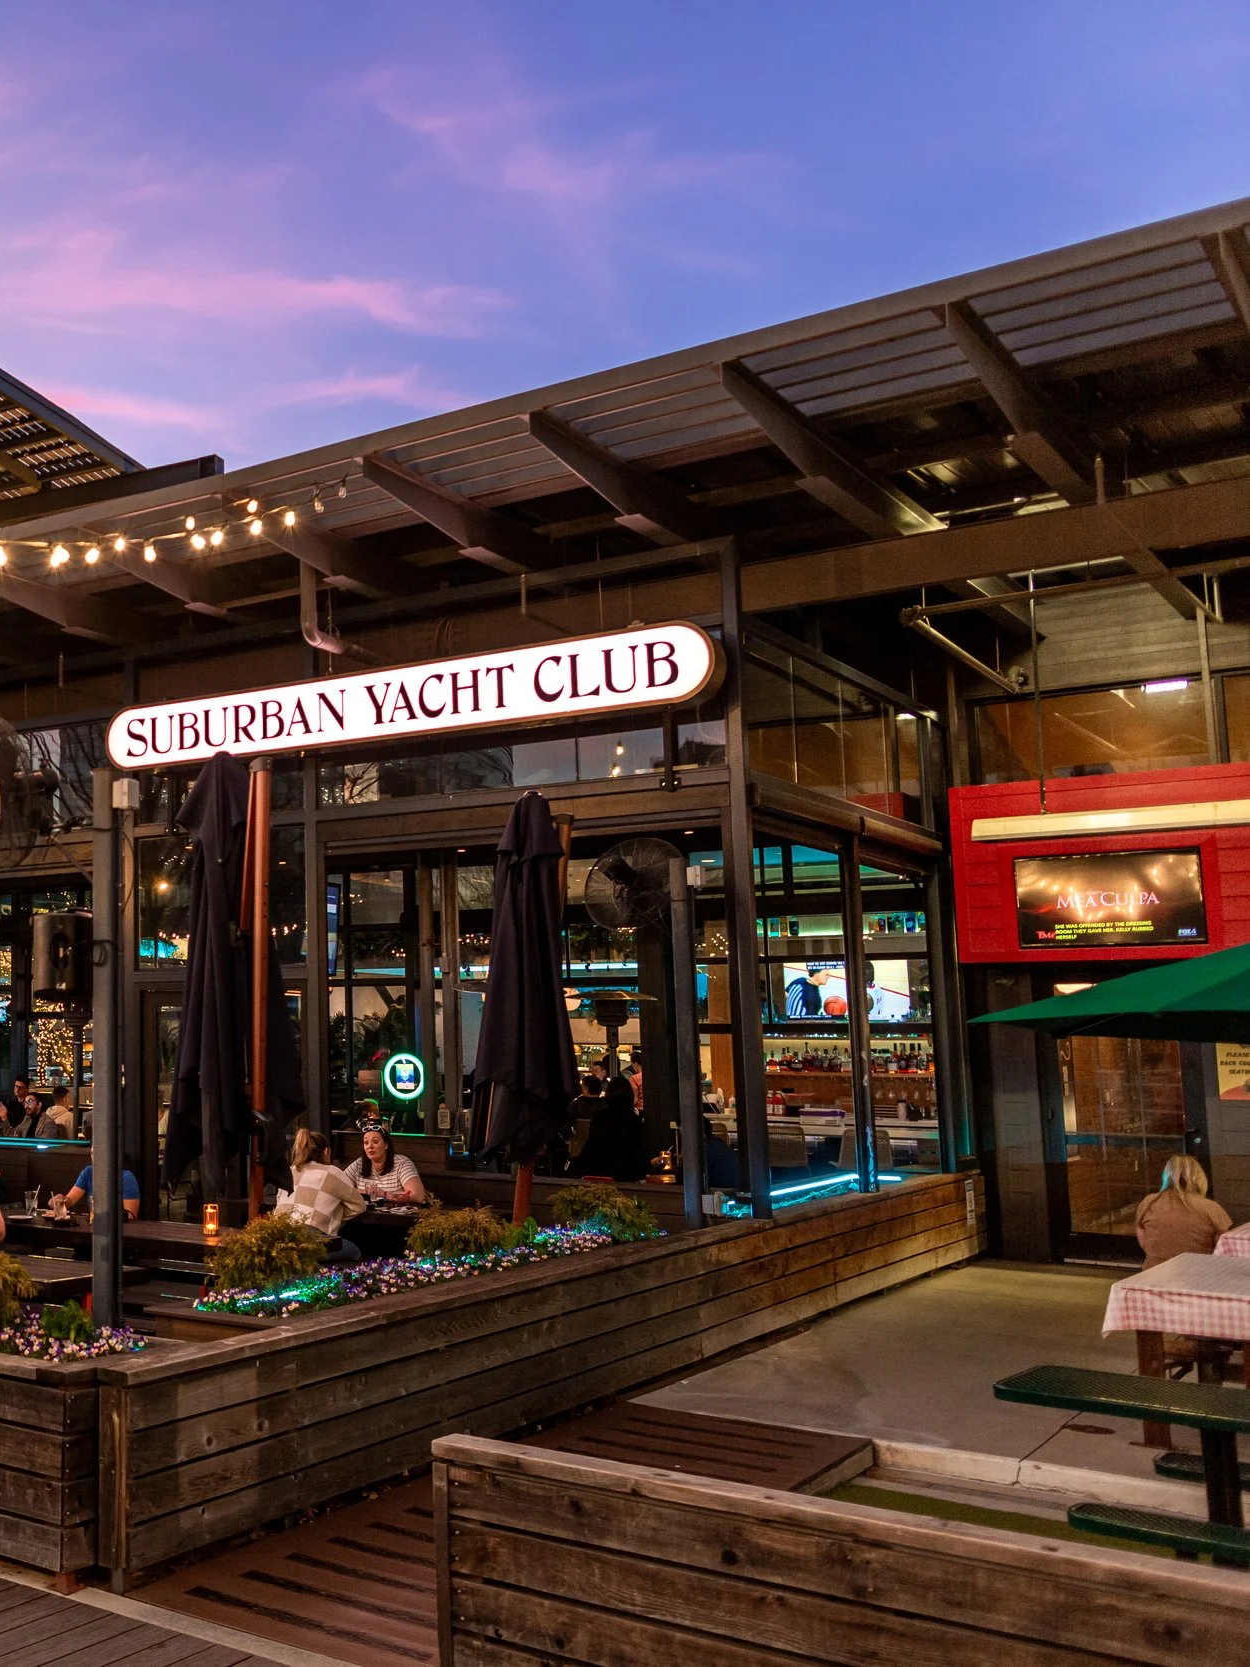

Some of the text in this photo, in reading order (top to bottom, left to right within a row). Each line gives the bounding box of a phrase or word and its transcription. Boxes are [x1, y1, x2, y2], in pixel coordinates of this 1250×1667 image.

[126, 641, 679, 757] SUBURBAN YACHT CLUB
[1057, 891, 1160, 909] MEA CULPA
